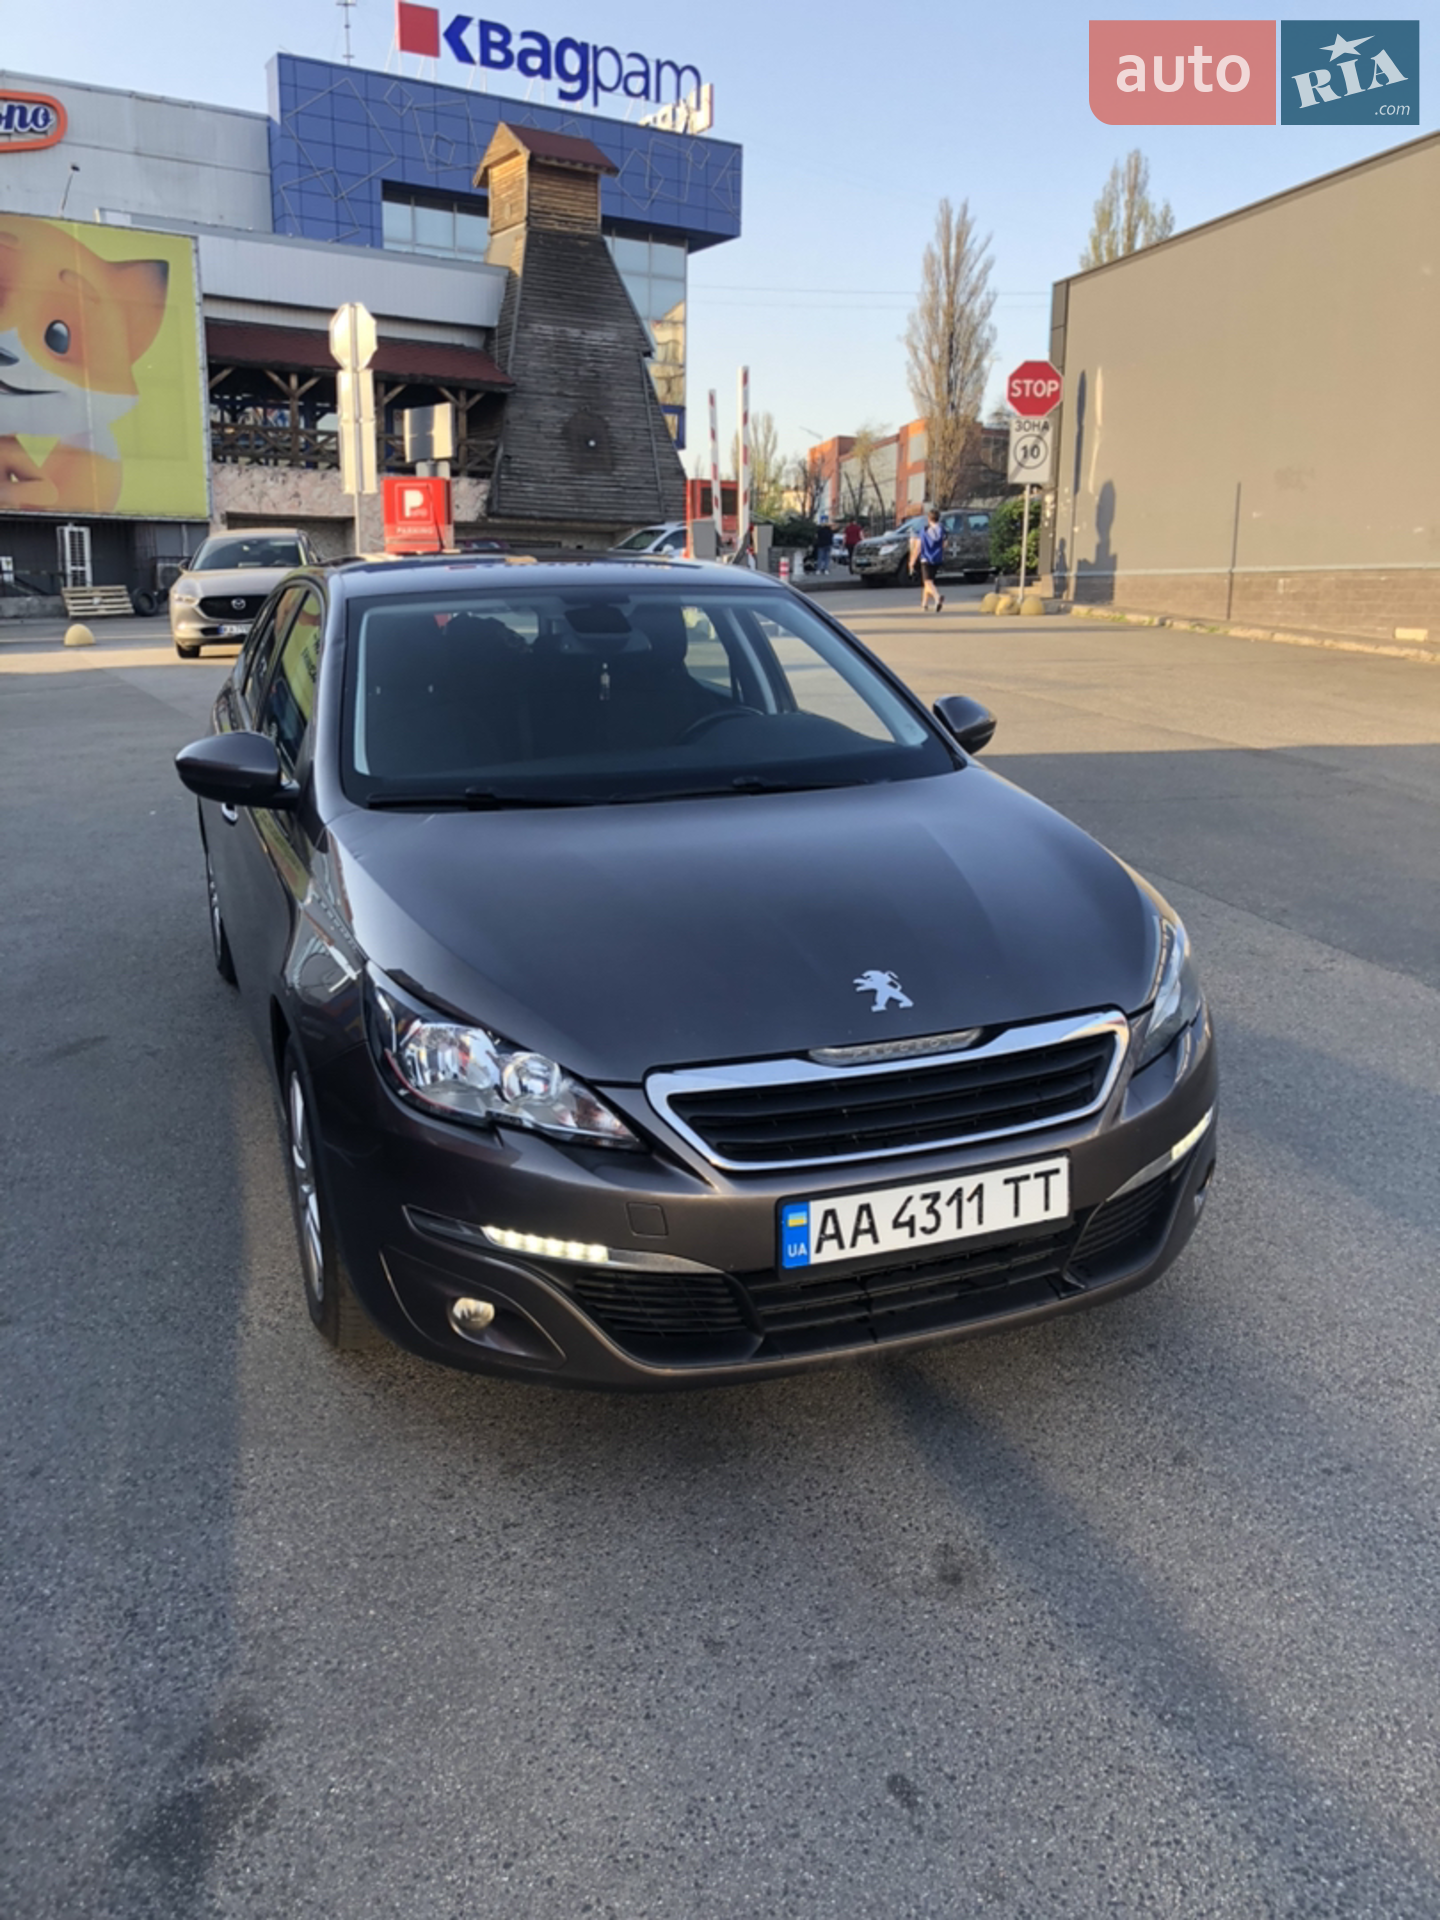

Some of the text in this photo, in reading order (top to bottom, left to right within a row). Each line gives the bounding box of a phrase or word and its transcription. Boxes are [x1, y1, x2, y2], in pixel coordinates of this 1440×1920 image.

[0, 103, 53, 132] по
[1010, 378, 1060, 399] STOP
[1014, 420, 1050, 433] ЗОНА
[1020, 444, 1041, 460] 10
[814, 1167, 1061, 1254] AA 4311 TT
[787, 1242, 808, 1258] UA
